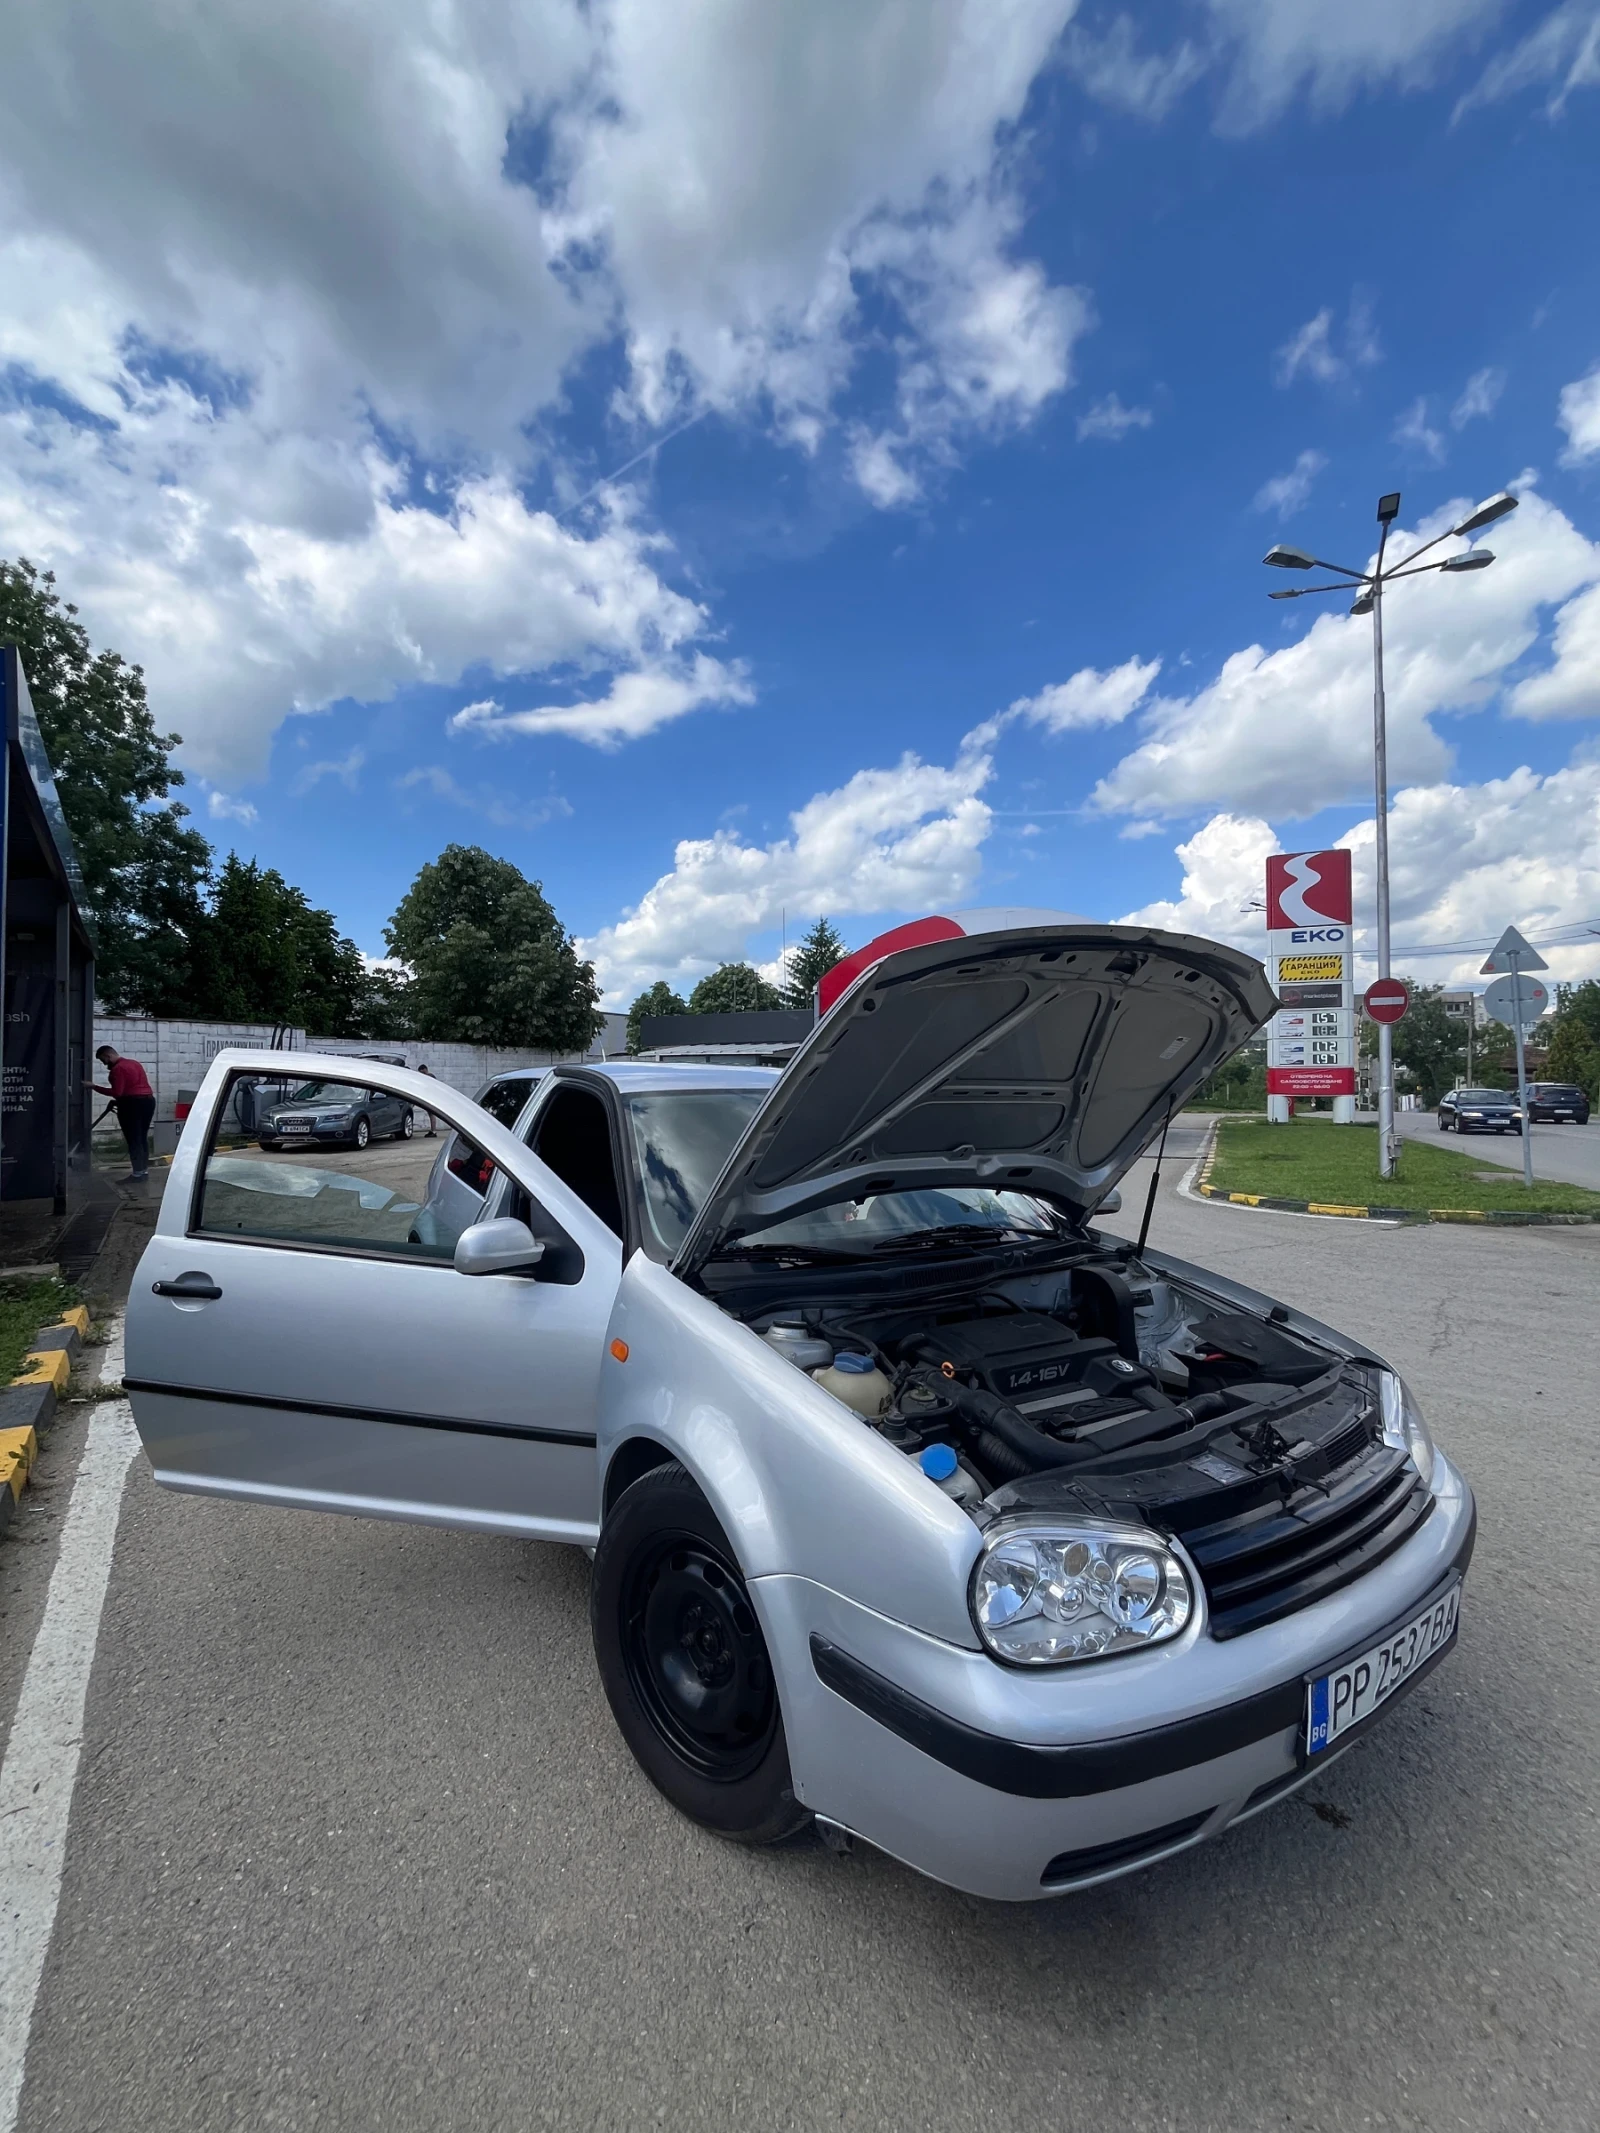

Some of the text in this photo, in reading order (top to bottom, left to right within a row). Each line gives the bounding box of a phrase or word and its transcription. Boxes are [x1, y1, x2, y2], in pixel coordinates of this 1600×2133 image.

[1291, 928, 1344, 943] EKO
[1286, 962, 1336, 971] ГАРАНЦИЯ
[1009, 1362, 1071, 1388] 1.4-16V
[1312, 1722, 1327, 1743] BG
